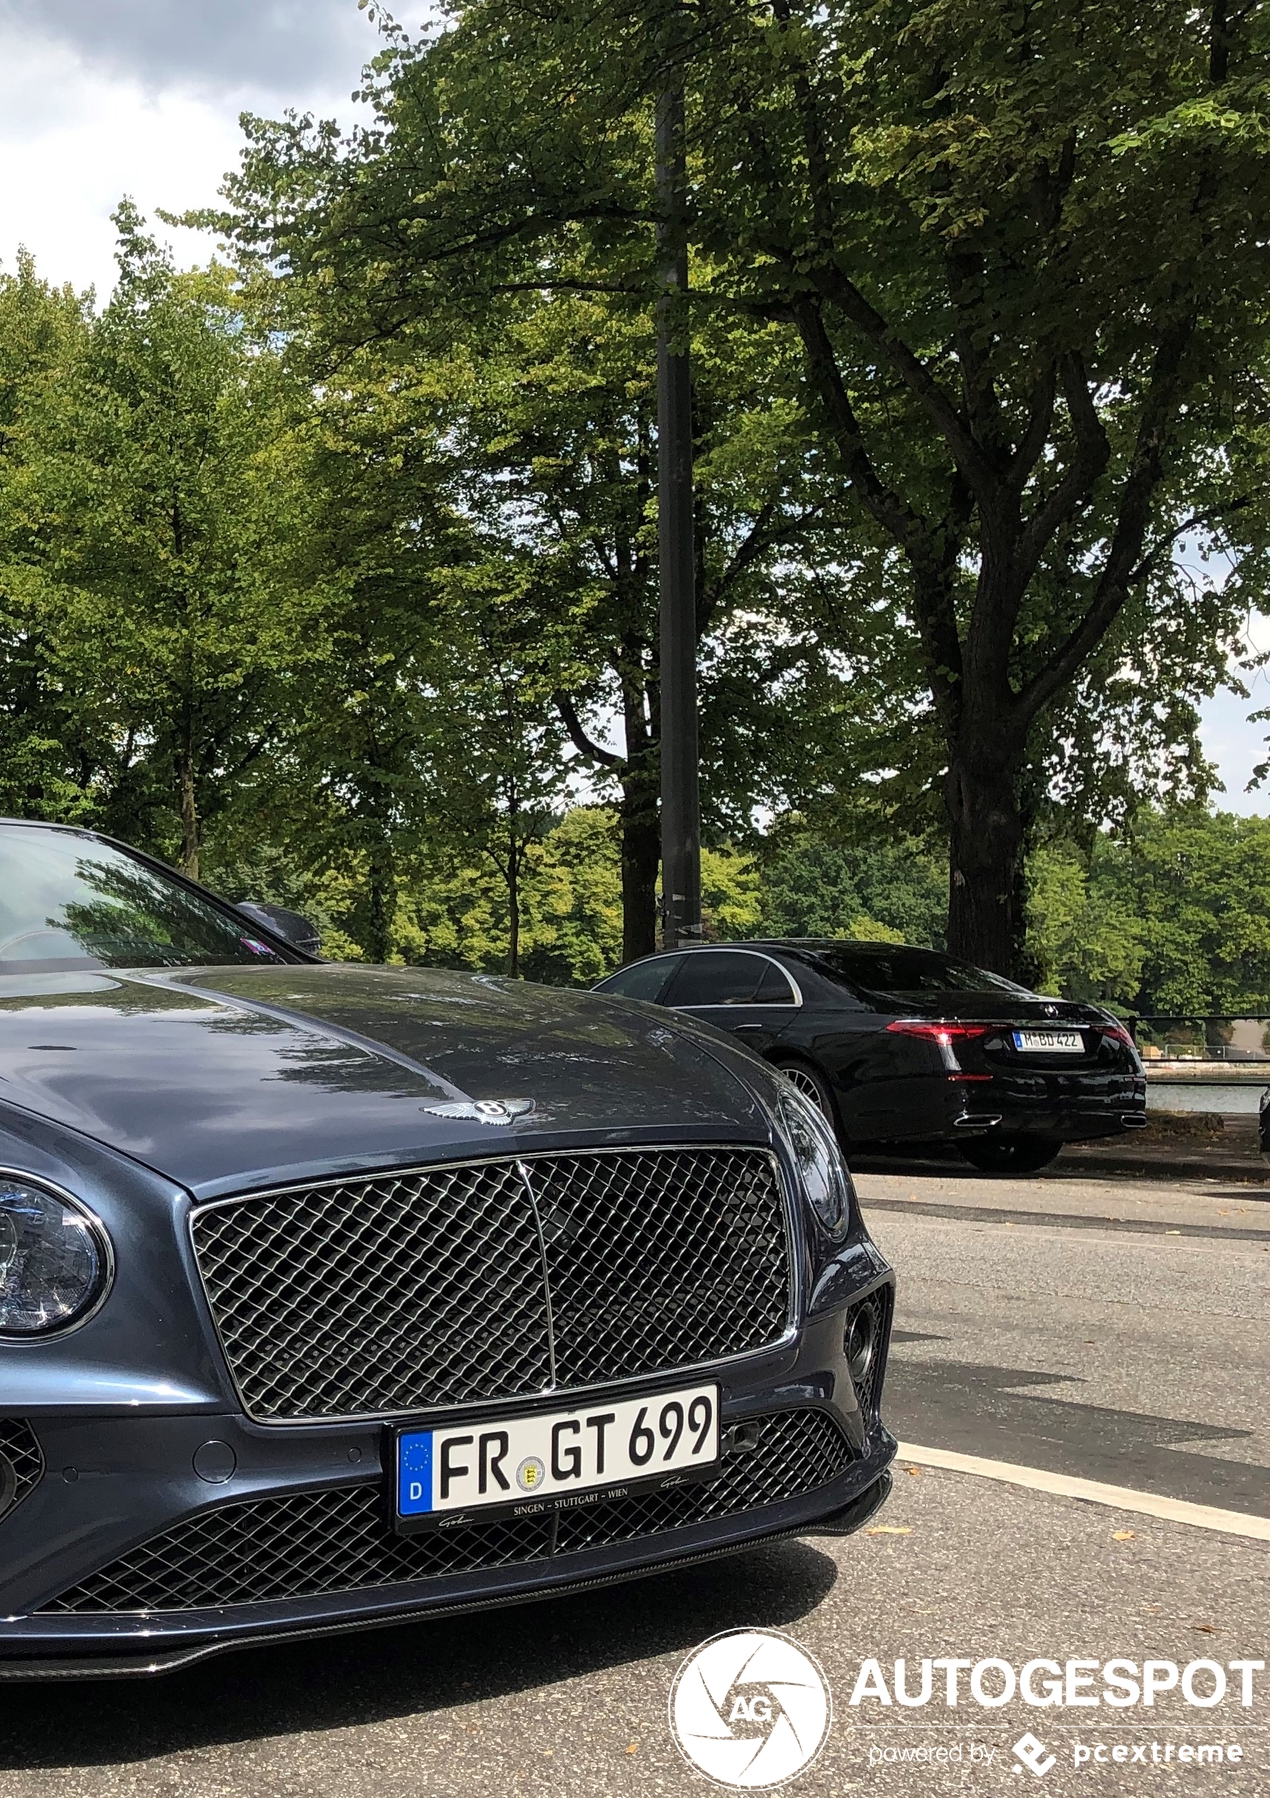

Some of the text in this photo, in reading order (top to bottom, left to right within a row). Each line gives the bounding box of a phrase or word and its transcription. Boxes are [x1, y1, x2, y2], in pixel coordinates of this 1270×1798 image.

[1038, 1033, 1054, 1047] BD
[1057, 1033, 1078, 1047] 422
[440, 1430, 510, 1500] FR
[550, 1413, 616, 1481] GT
[628, 1395, 713, 1467] 699
[410, 1482, 422, 1500] D
[513, 1503, 545, 1516] SINGEN
[554, 1493, 599, 1509] STUTTGART
[608, 1488, 628, 1499] WIEN
